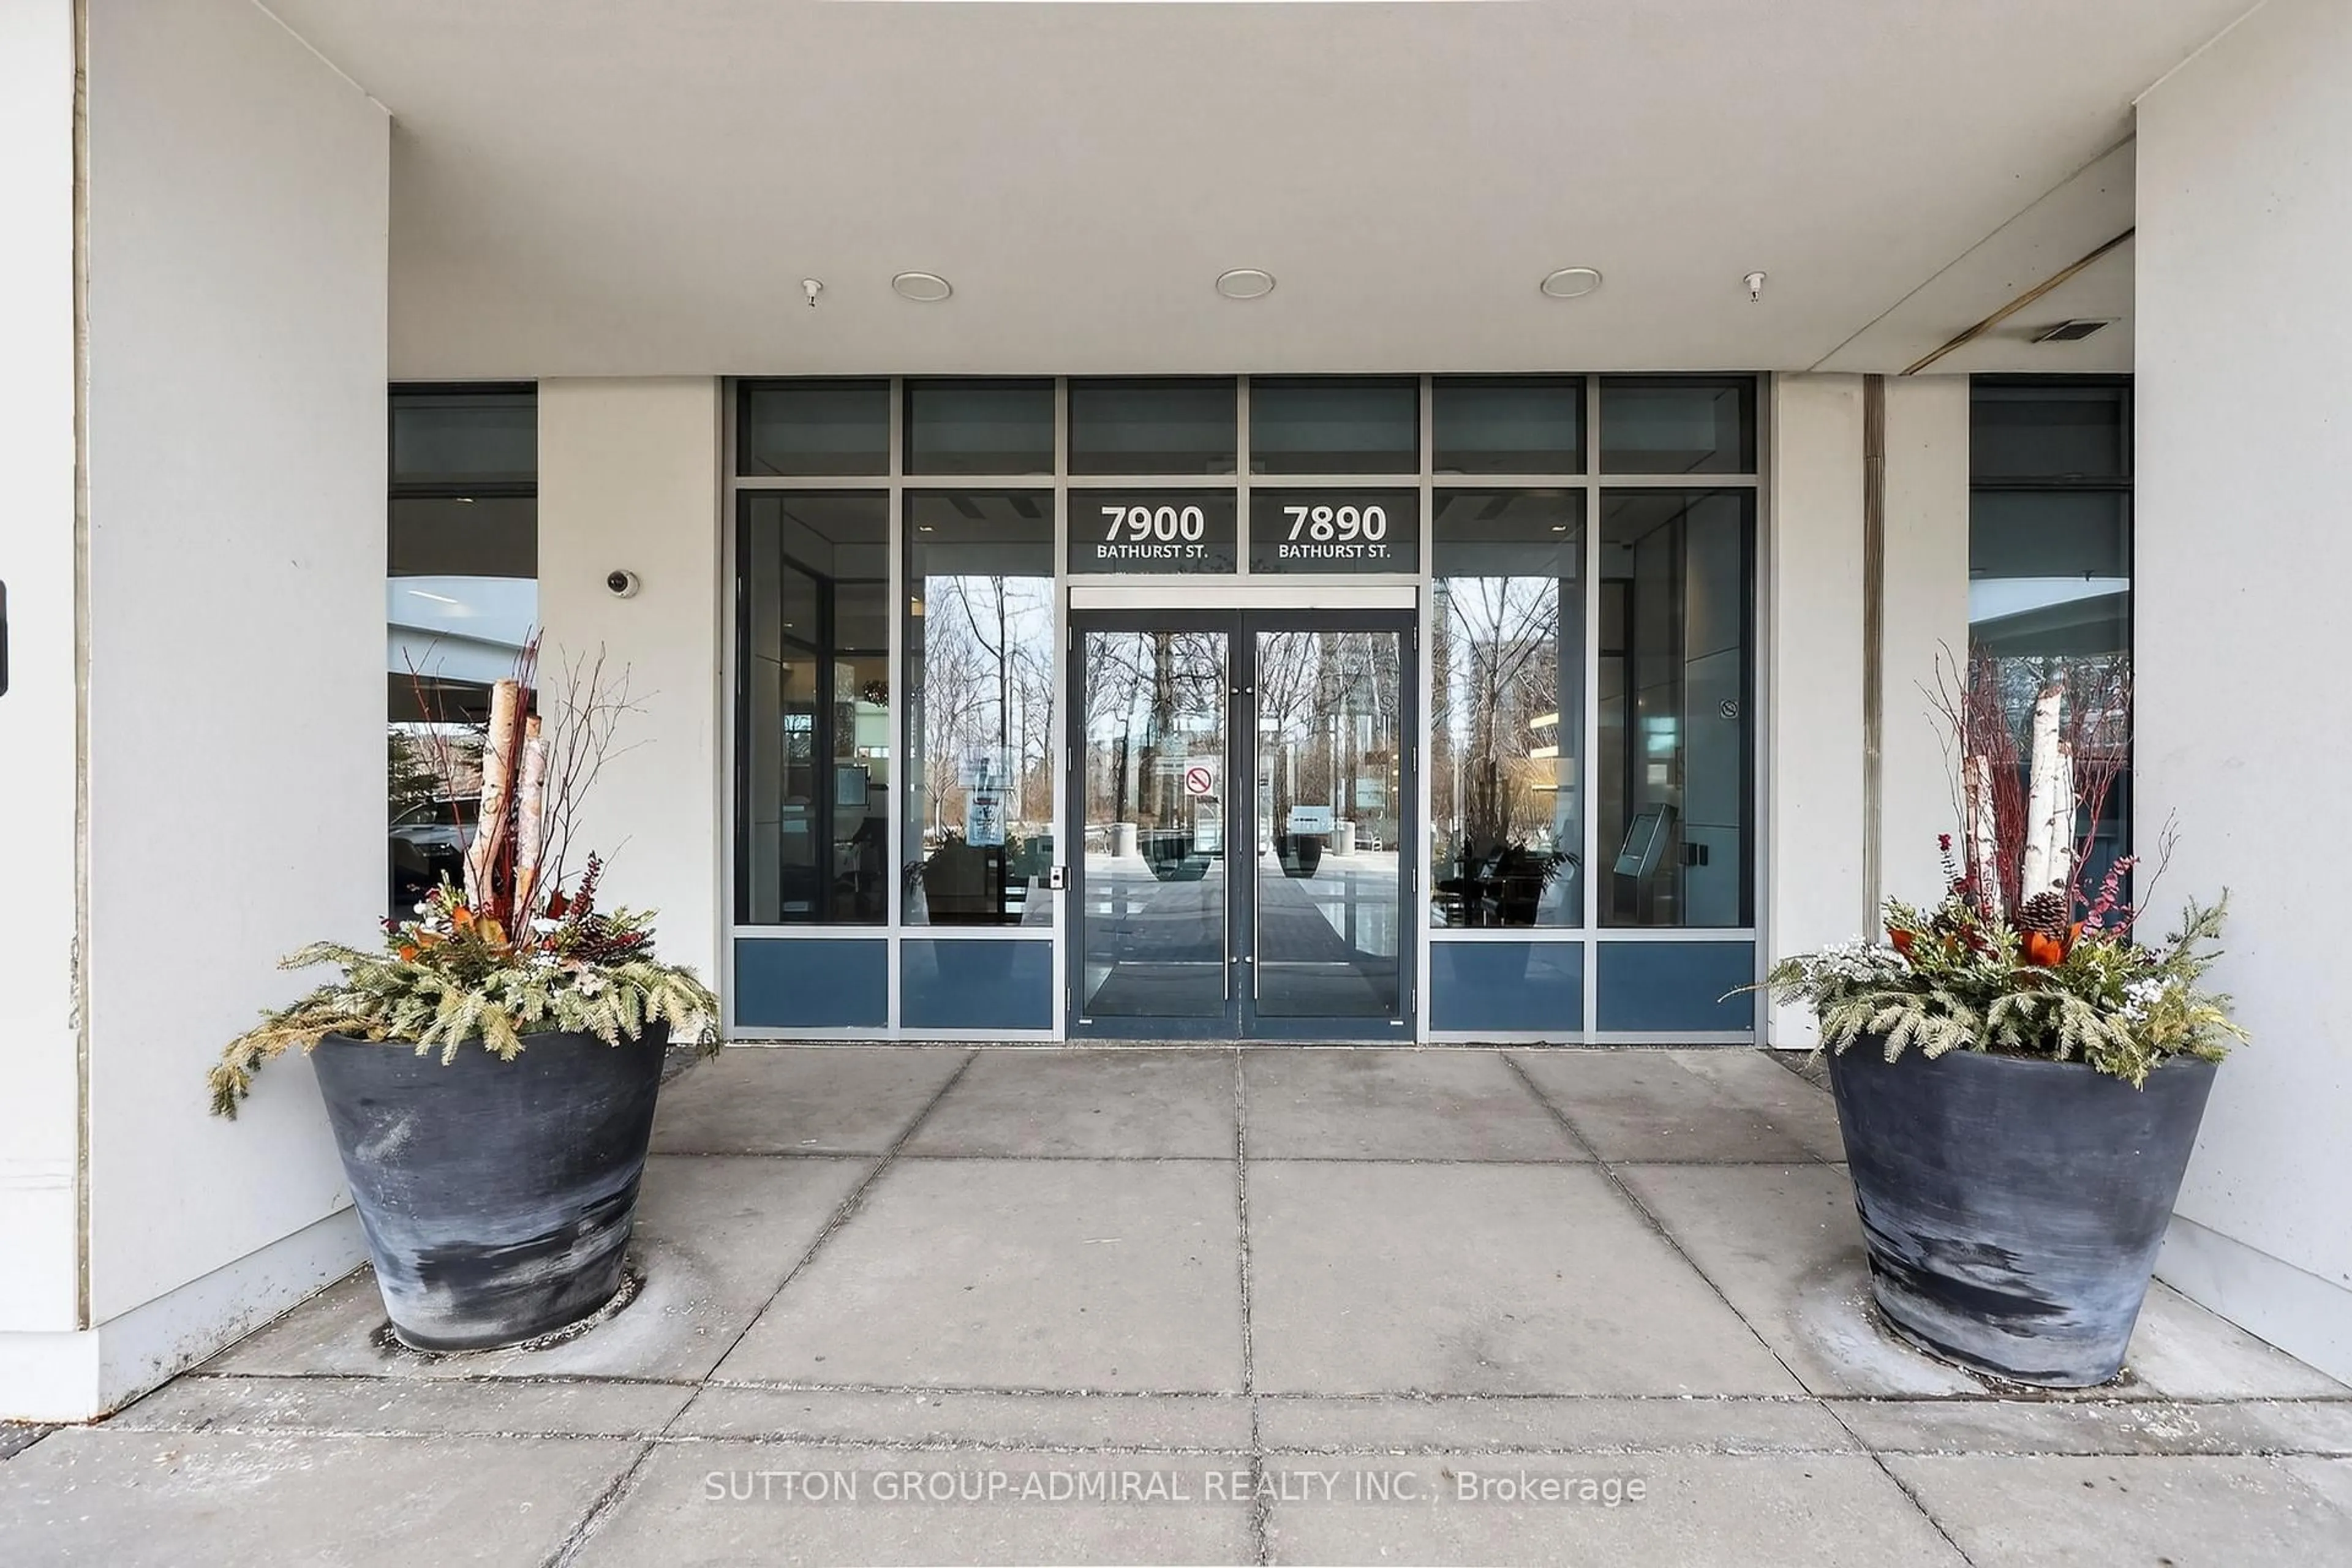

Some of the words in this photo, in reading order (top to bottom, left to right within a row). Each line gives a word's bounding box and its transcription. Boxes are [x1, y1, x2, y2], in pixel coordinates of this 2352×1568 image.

[1101, 505, 1204, 541] 7900
[1283, 505, 1387, 541] 7890
[1096, 543, 1182, 559] BATHURST
[1185, 543, 1208, 559] ST.
[1278, 543, 1365, 559] BATHURST
[1368, 543, 1391, 559] ST.
